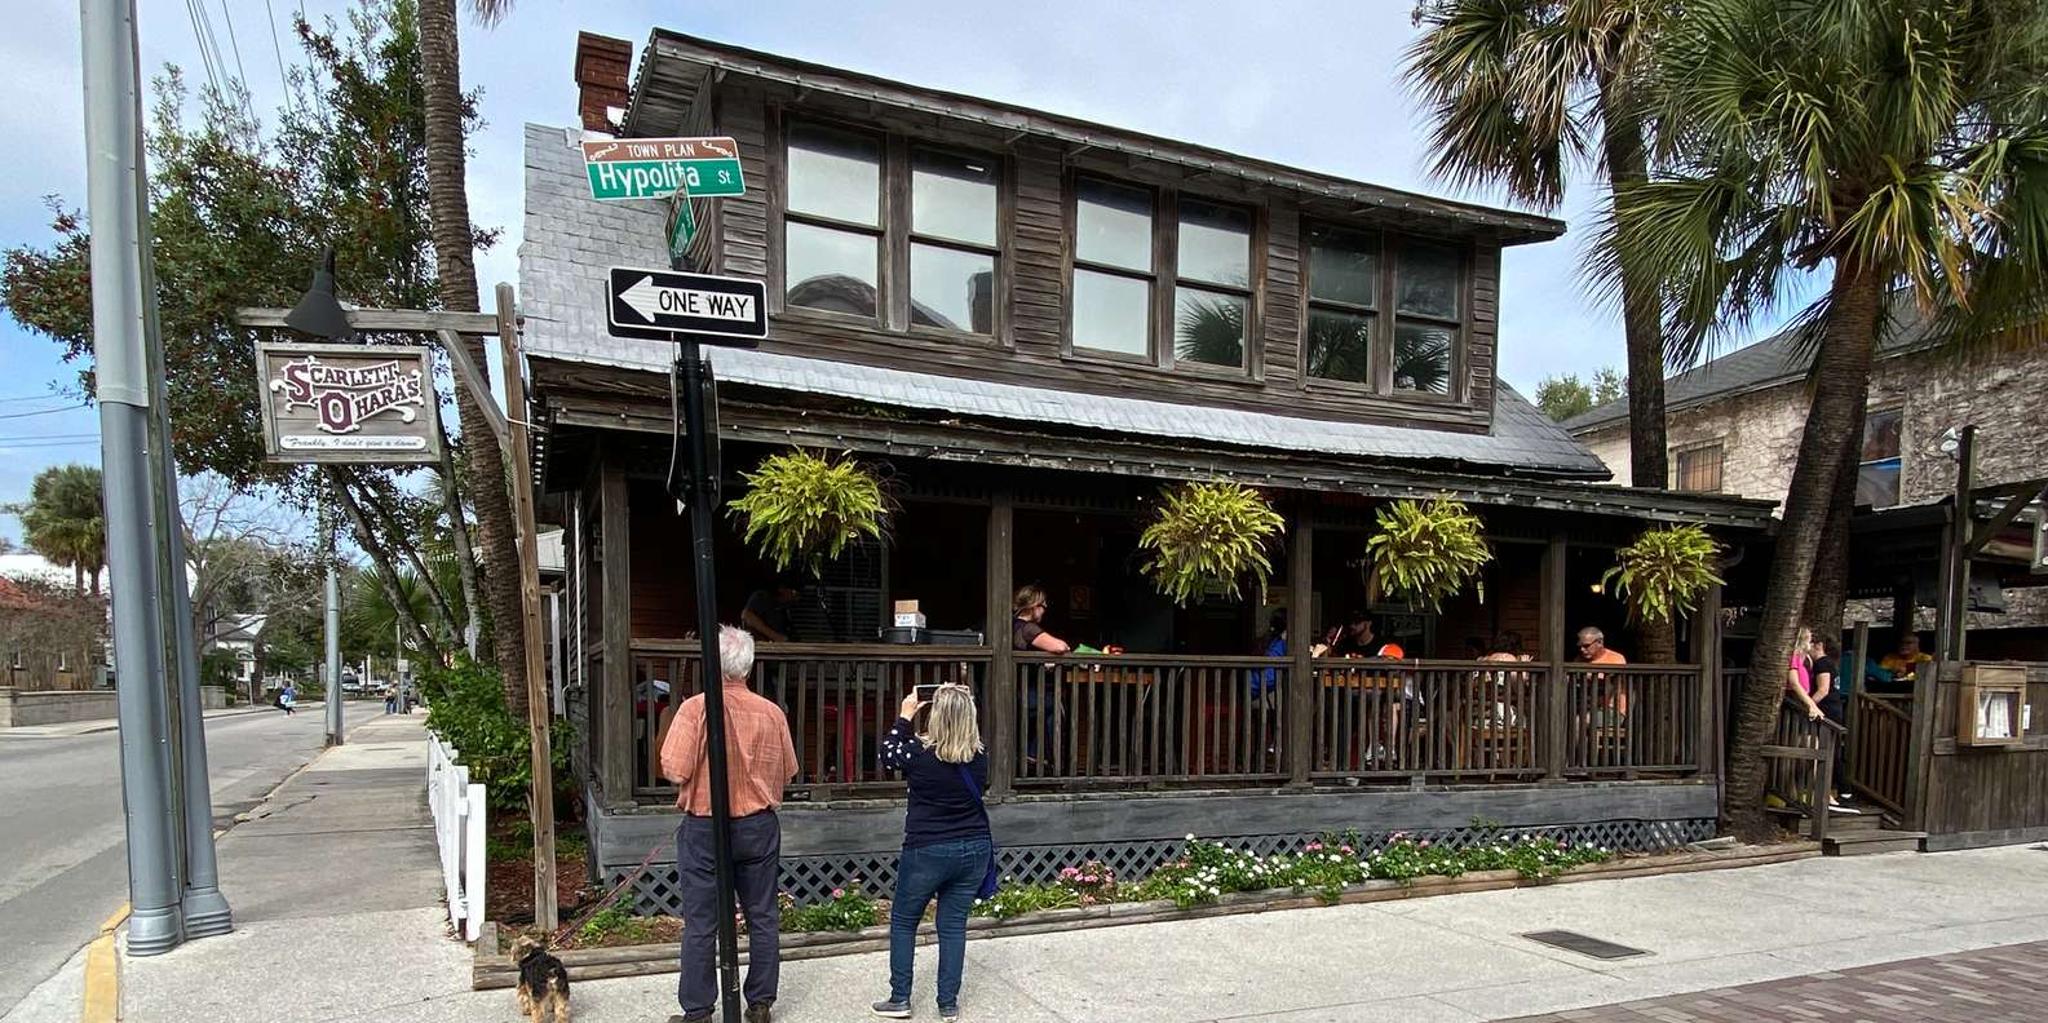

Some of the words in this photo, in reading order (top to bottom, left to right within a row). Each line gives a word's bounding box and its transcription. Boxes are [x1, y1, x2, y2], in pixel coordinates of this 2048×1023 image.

[626, 144, 658, 158] TOWN
[664, 143, 695, 157] PLAN
[596, 161, 701, 197] Hypolita
[659, 289, 700, 314] ONE
[706, 295, 749, 318] WAY
[283, 361, 400, 402] SCARLETT
